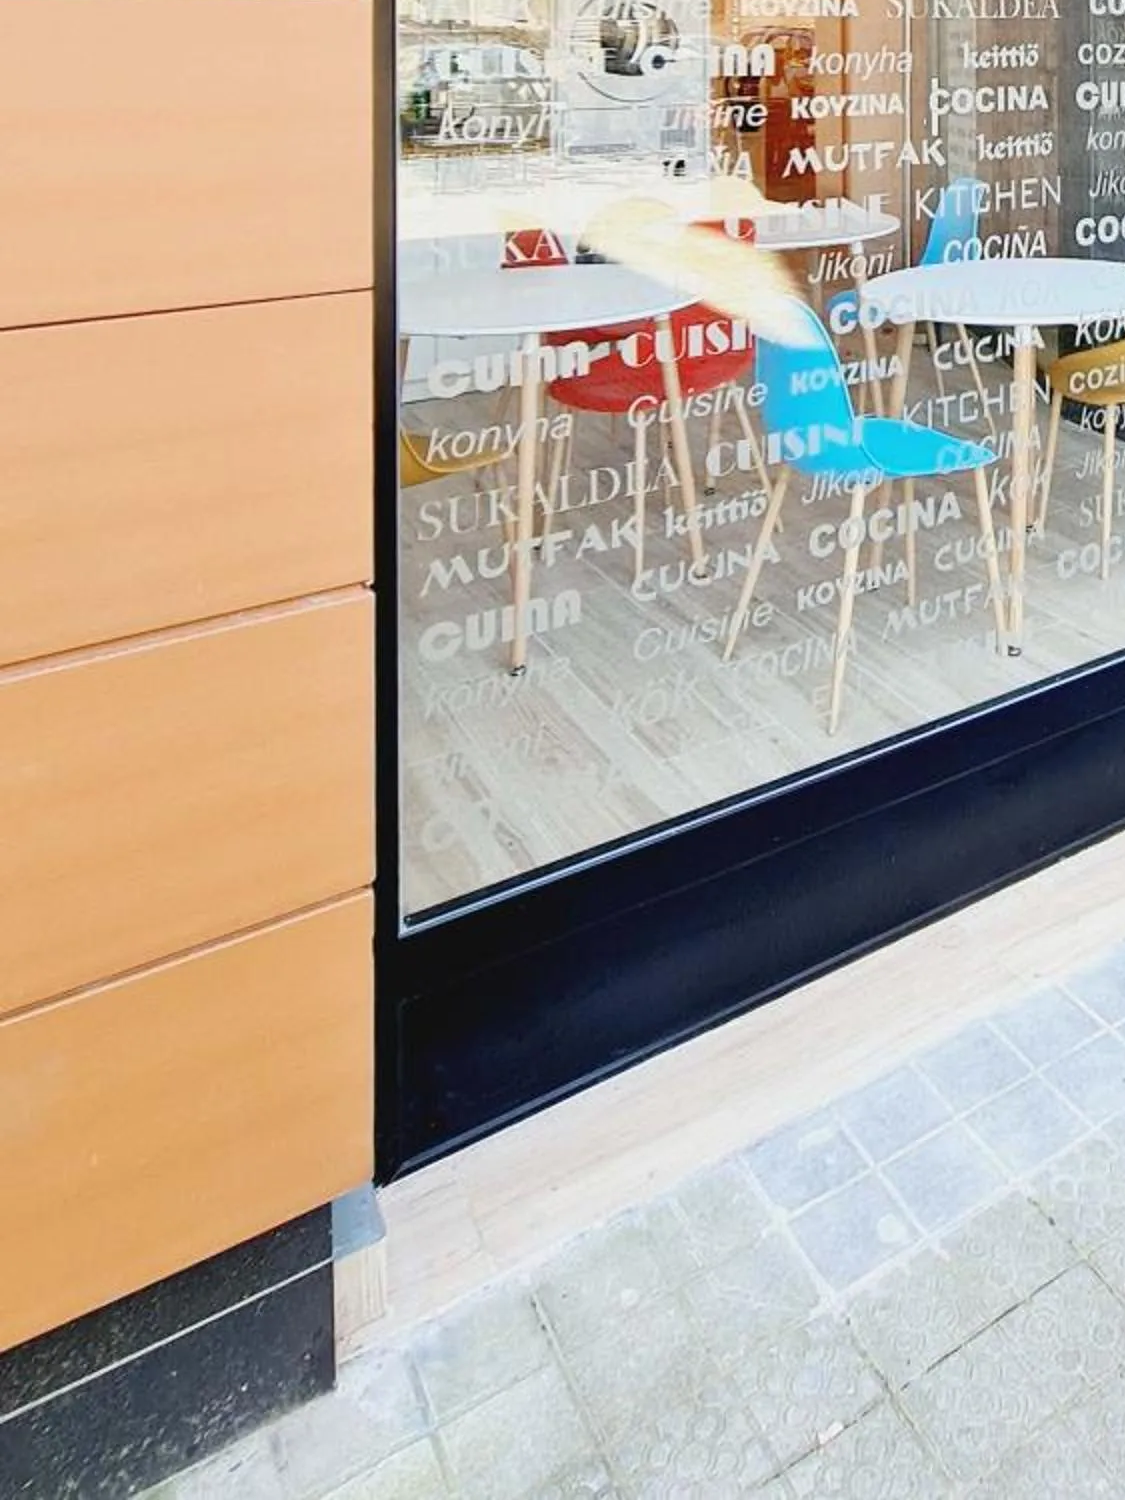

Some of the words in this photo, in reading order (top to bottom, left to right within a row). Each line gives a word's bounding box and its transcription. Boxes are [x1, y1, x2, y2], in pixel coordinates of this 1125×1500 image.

[808, 43, 914, 82] konyha
[928, 84, 1050, 117] COCINA
[782, 135, 947, 179] MUTFAK
[913, 175, 1063, 222] KITCHEN
[808, 243, 896, 285] Jikoni
[932, 326, 1047, 371] CUCINA
[809, 490, 964, 558] COCINA
